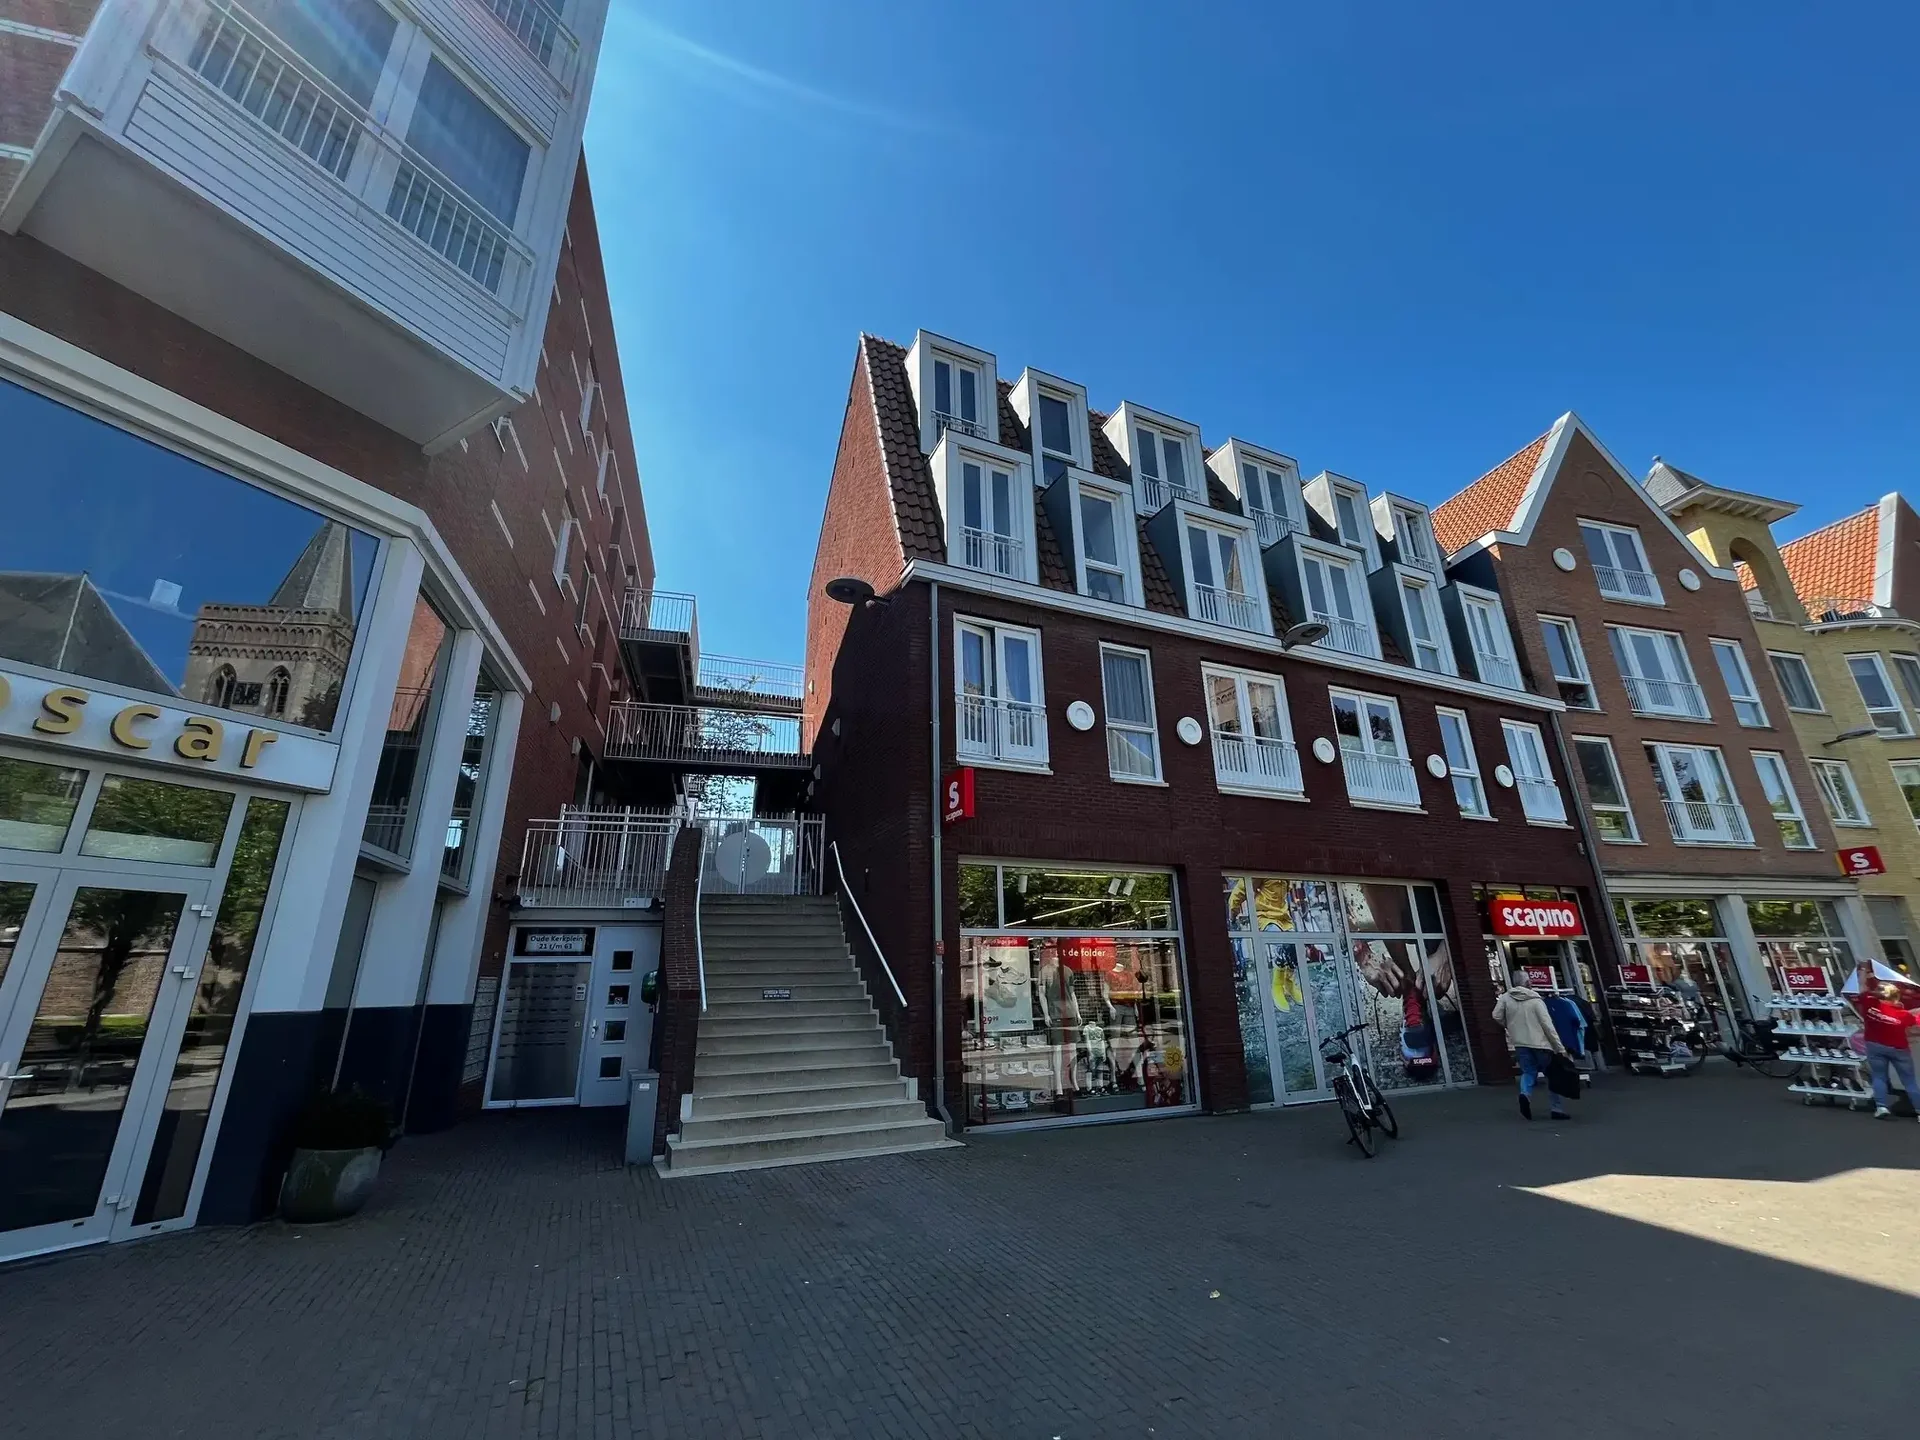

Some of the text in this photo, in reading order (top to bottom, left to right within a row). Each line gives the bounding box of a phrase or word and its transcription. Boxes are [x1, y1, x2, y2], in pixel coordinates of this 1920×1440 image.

[0, 672, 279, 769] scar
[1502, 907, 1575, 935] scapino
[1068, 947, 1079, 957] de
[1081, 947, 1106, 957] folder
